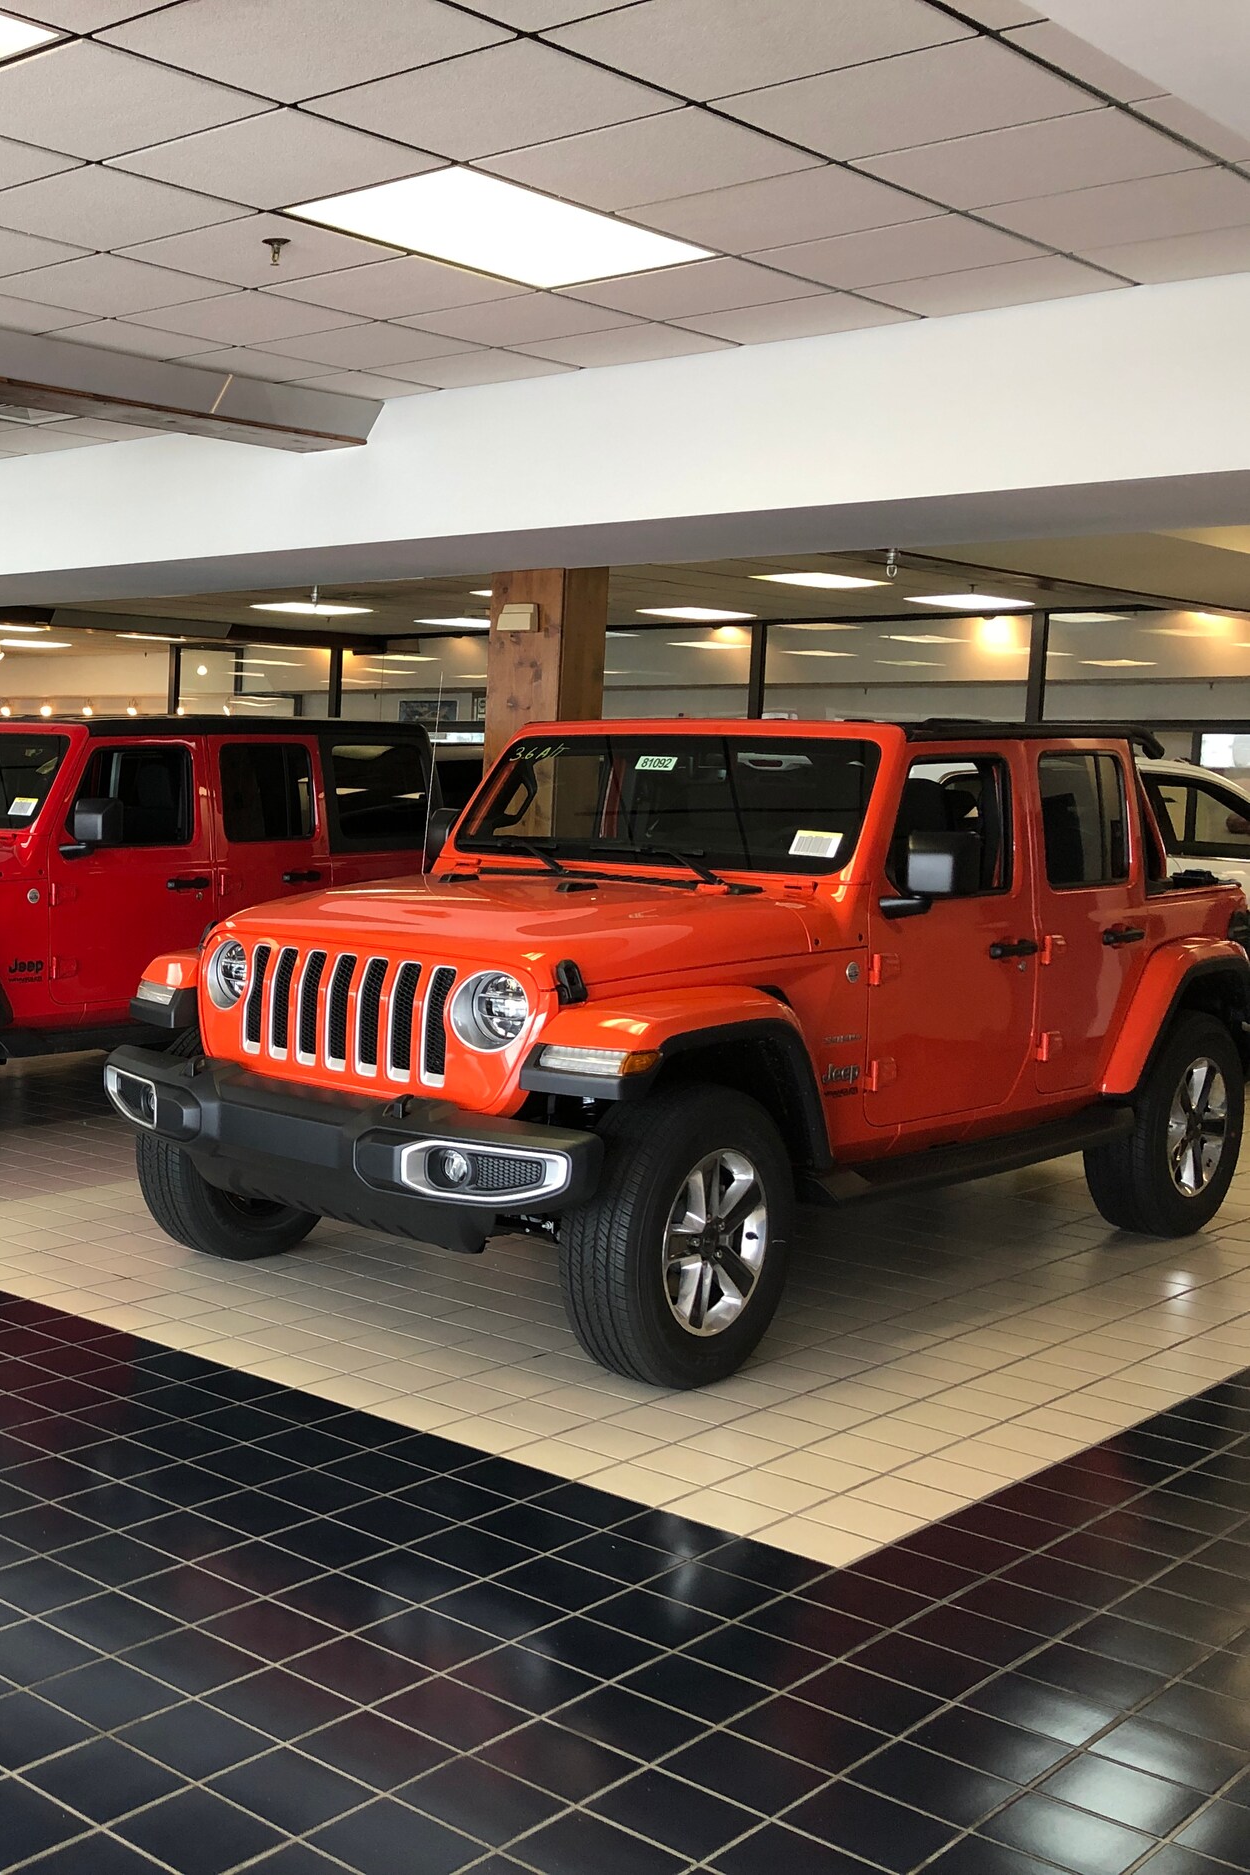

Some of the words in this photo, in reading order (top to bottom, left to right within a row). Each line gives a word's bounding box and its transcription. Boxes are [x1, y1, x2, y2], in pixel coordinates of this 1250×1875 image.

[509, 746, 538, 761] 3.6
[641, 757, 673, 769] 81092
[8, 957, 45, 974] Jeep
[821, 1063, 860, 1085] Jeep
